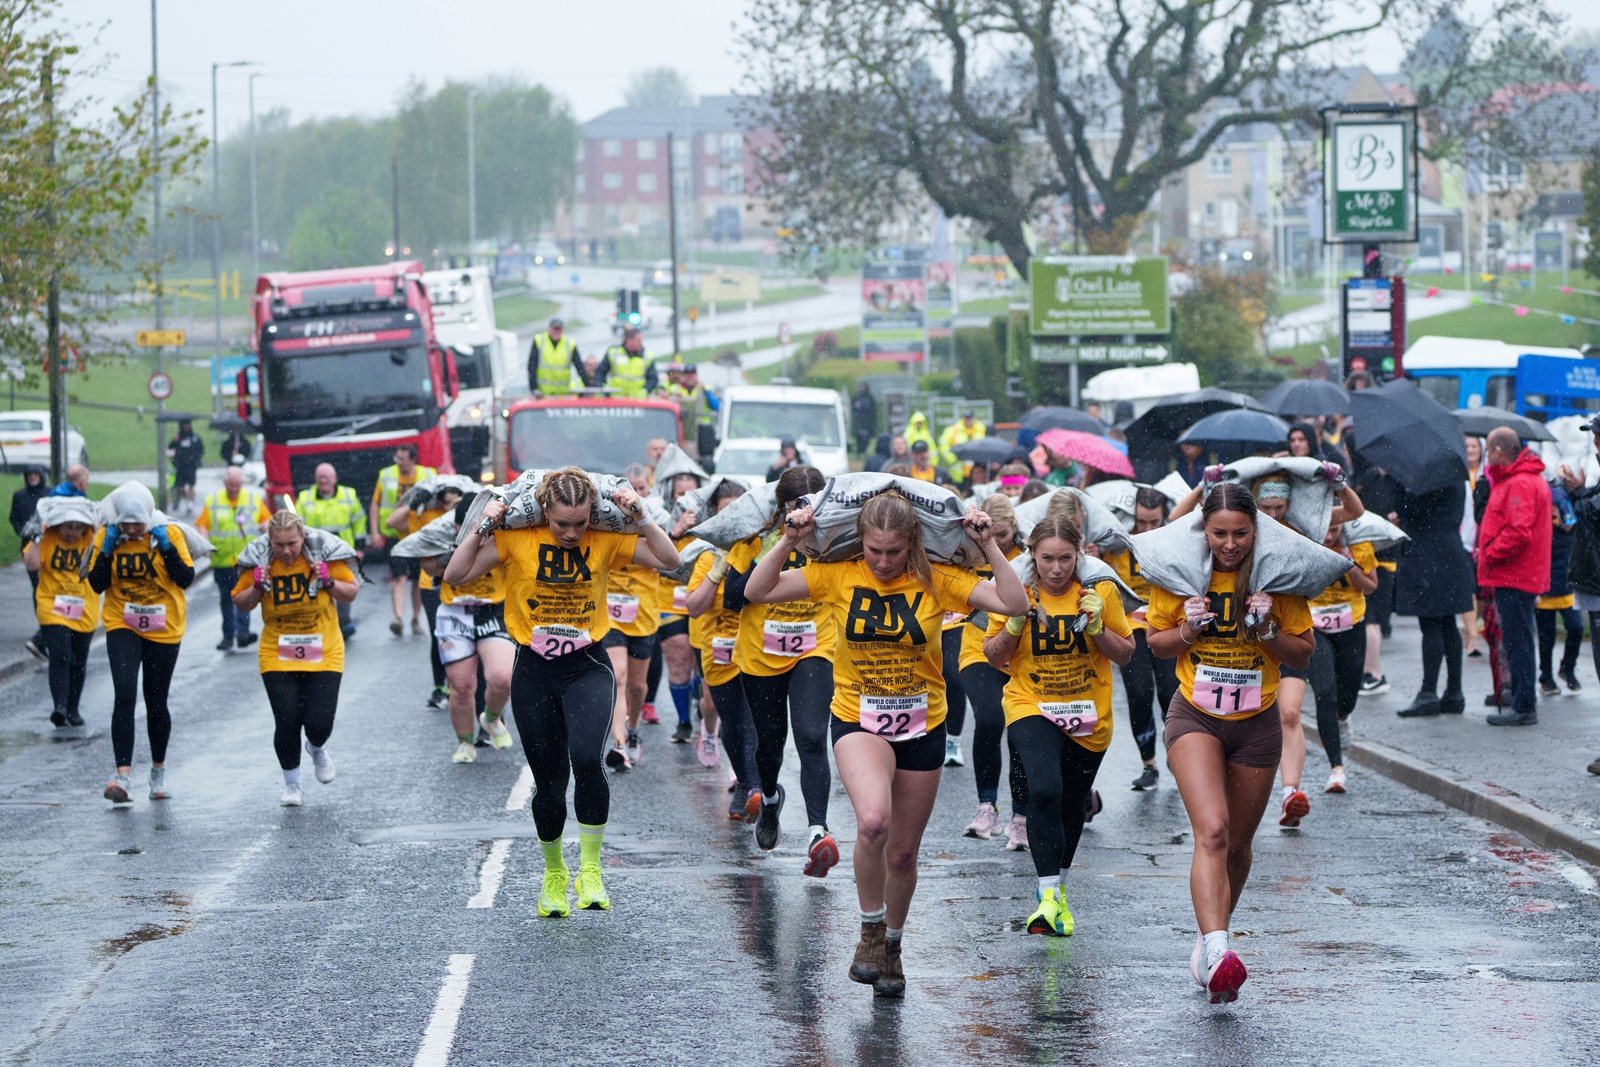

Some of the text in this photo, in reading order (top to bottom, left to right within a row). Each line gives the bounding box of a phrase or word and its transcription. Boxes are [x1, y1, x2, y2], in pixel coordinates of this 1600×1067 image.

[1345, 132, 1395, 181] B's
[304, 320, 334, 337] FH
[1079, 346, 1107, 360] NEXT
[546, 407, 645, 418] YORKSHIRE
[117, 552, 159, 579] BOX
[612, 605, 622, 618] 5
[846, 587, 927, 645] BOX
[138, 616, 149, 629] 8
[477, 616, 501, 636] THAI
[1322, 616, 1341, 630] 21
[544, 638, 575, 658] 20
[778, 636, 804, 653] 12
[295, 646, 305, 659] 3
[863, 673, 914, 686] GAWTHORPE WORLD
[1203, 669, 1220, 678] WORLD
[851, 683, 862, 694] COAL
[864, 684, 889, 696] CARRYING
[1211, 686, 1241, 711] 11
[877, 712, 911, 736] 22
